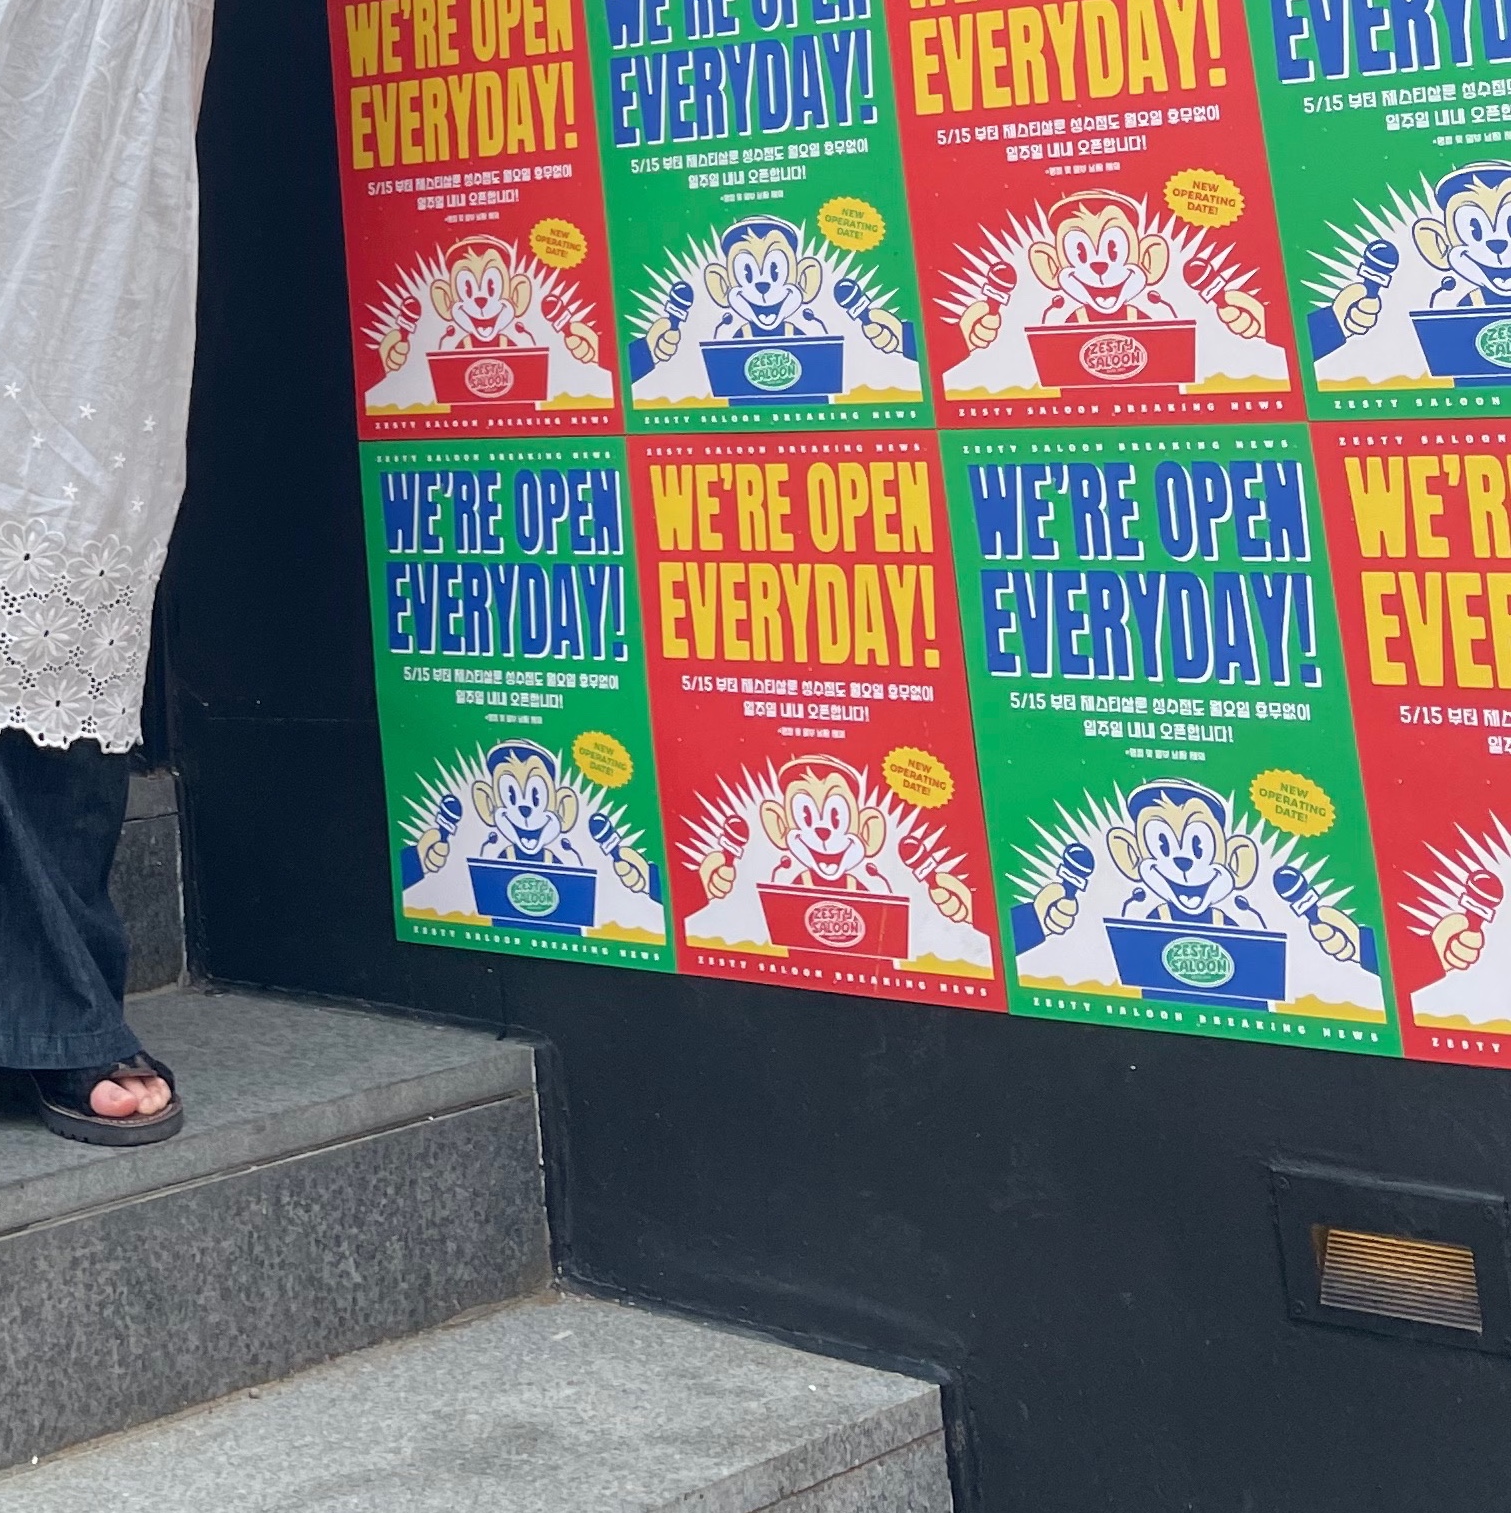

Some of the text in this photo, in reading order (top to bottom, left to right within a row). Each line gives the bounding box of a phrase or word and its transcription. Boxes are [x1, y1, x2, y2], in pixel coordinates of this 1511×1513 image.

[610, 27, 877, 149] EVERYDAY!
[1302, 93, 1344, 114] 5/15
[1347, 91, 1377, 110] 부터
[1380, 83, 1457, 106] 제스티살룬
[351, 61, 578, 170] EVERYDAY!
[936, 104, 1220, 145] 5/15 부터 제스티살룬 성수점도 월요일 휴무없이
[1384, 111, 1431, 131] 일주일
[1433, 107, 1466, 127] 내내
[630, 138, 868, 173] 5/15 부터 제스티살룬 성수점도 월요일 휴무없이
[1005, 135, 1147, 161] 일주일 내내 오픈합니다!
[368, 180, 393, 195] 5/15
[395, 178, 413, 193] 부터
[687, 165, 806, 189] 일주일 내내 오픈합니다!
[1193, 181, 1219, 192] NEW
[416, 195, 444, 210] 일주일
[446, 193, 466, 208] 내내
[1173, 188, 1235, 207] OPERATING
[842, 208, 864, 219] NEW
[1188, 202, 1218, 214] DATE!
[825, 215, 877, 232] OPERATING
[838, 227, 863, 239] DATE!
[1090, 338, 1133, 354] ZESTY
[753, 353, 789, 367] ZESTY
[1088, 351, 1139, 369] SALOON
[751, 365, 794, 380] SALOON
[958, 401, 1283, 416] ZESTY SALOON BREAKING NEWS
[1333, 396, 1501, 408] ZESTY SALOON
[963, 440, 1288, 453] ZESTY SALOON BREAKING NEWS
[1339, 434, 1507, 445] ZESTY SALOON
[650, 454, 937, 550] WE'RE OPEN
[967, 461, 1311, 561] WE'RE OPEN
[1344, 454, 1511, 558] WE'R
[380, 470, 622, 555] WE'RE OPEN
[387, 561, 627, 662] EVERYDAY!
[659, 562, 944, 667] EVERYDAY!
[980, 569, 1322, 688] EVERYDAY!
[681, 675, 935, 702] 5/15 부터 제스티살룬 성수점도 월요일 휴무없이
[742, 700, 870, 722] 일주일 내내 오픈합니다!
[1009, 691, 1311, 721] 5/15 부터 제스티살룬 성수점도 월요일 휴무없이
[1398, 705, 1443, 725] 5/15
[1447, 707, 1479, 726] 부터
[1082, 719, 1234, 743] 일주일 내내 오픈합니다!
[908, 758, 932, 773] NEW
[890, 764, 946, 790] OPERATING
[904, 779, 930, 795] DATE!
[1280, 782, 1308, 798] NEW
[1260, 788, 1325, 816] OPERATING
[1276, 805, 1307, 822] DATE!
[813, 908, 852, 919] ZESTY
[812, 921, 858, 933] SALOON
[1173, 944, 1219, 957] ZESTY
[1171, 959, 1226, 972] SALOON
[1032, 996, 1379, 1043] ZESTY SALOON BREAKING NEWS
